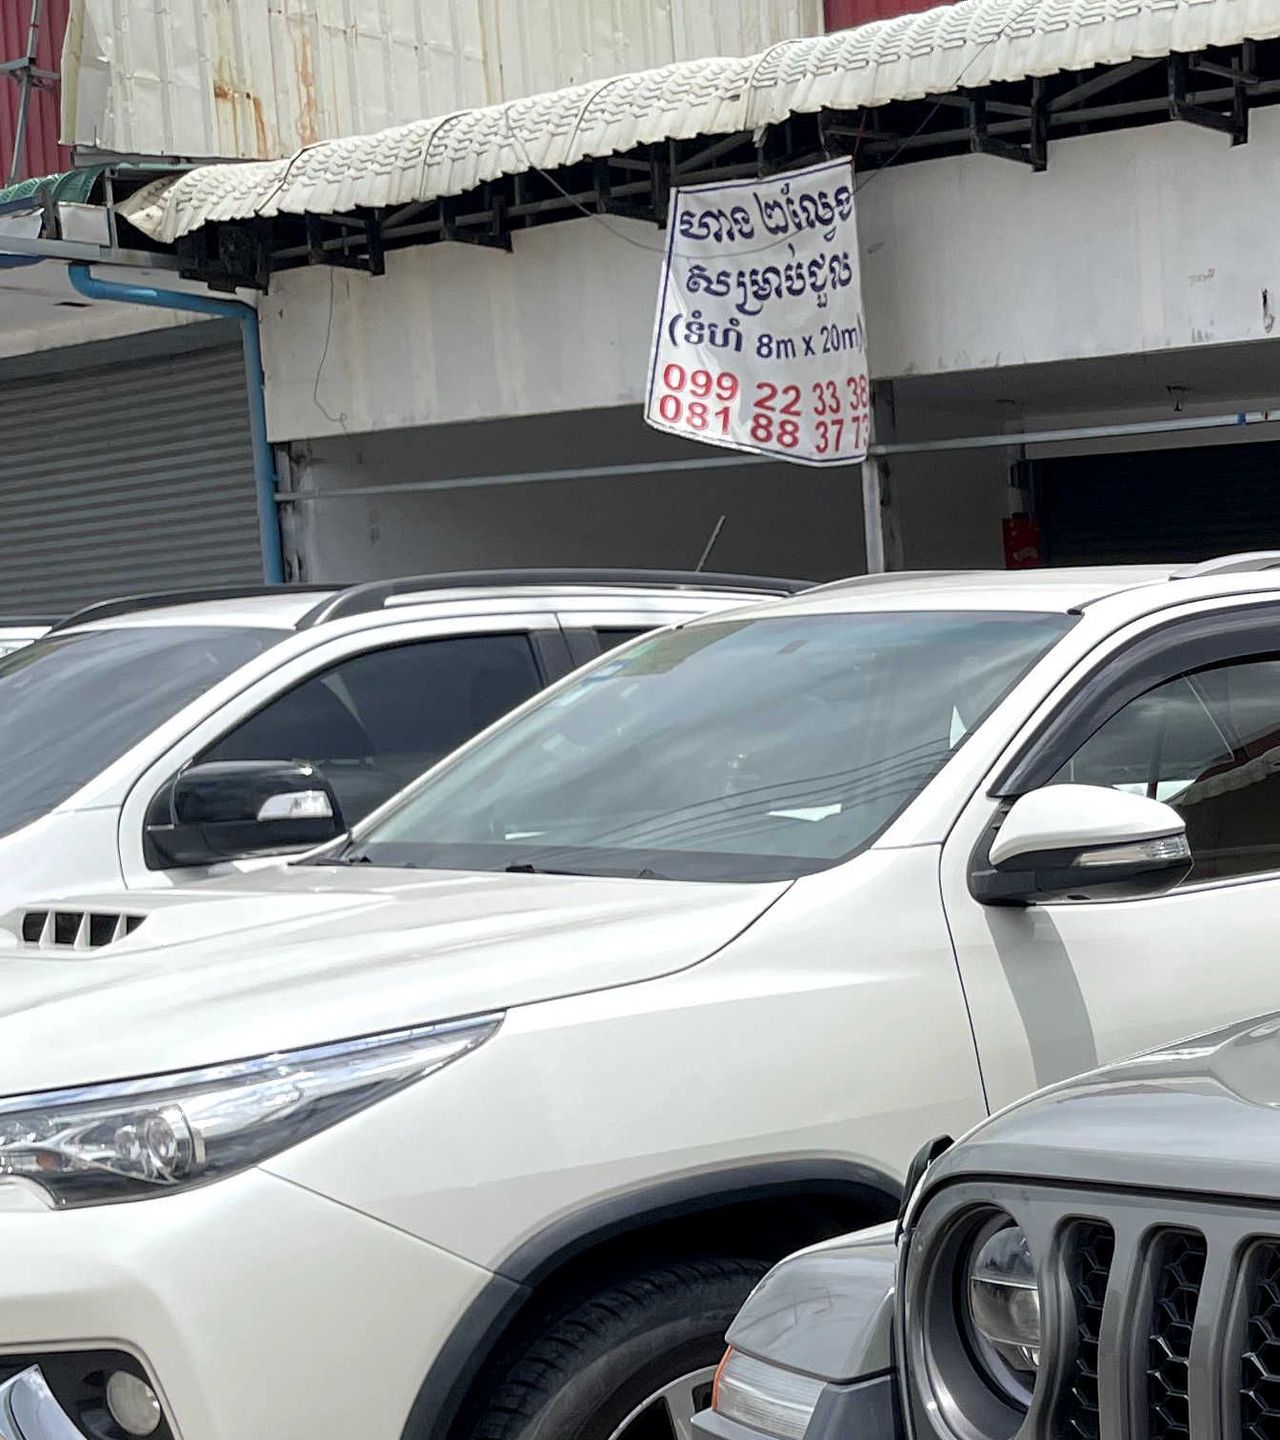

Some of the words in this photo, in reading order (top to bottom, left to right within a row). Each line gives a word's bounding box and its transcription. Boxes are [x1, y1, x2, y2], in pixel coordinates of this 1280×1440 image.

[756, 333, 796, 360] 8m
[802, 334, 815, 357] x
[662, 362, 739, 402] 099
[752, 382, 801, 417] 22
[812, 380, 841, 417] 33
[846, 373, 869, 412] 38
[658, 393, 731, 434] 081
[750, 412, 800, 449] 88
[814, 417, 844, 454] 37
